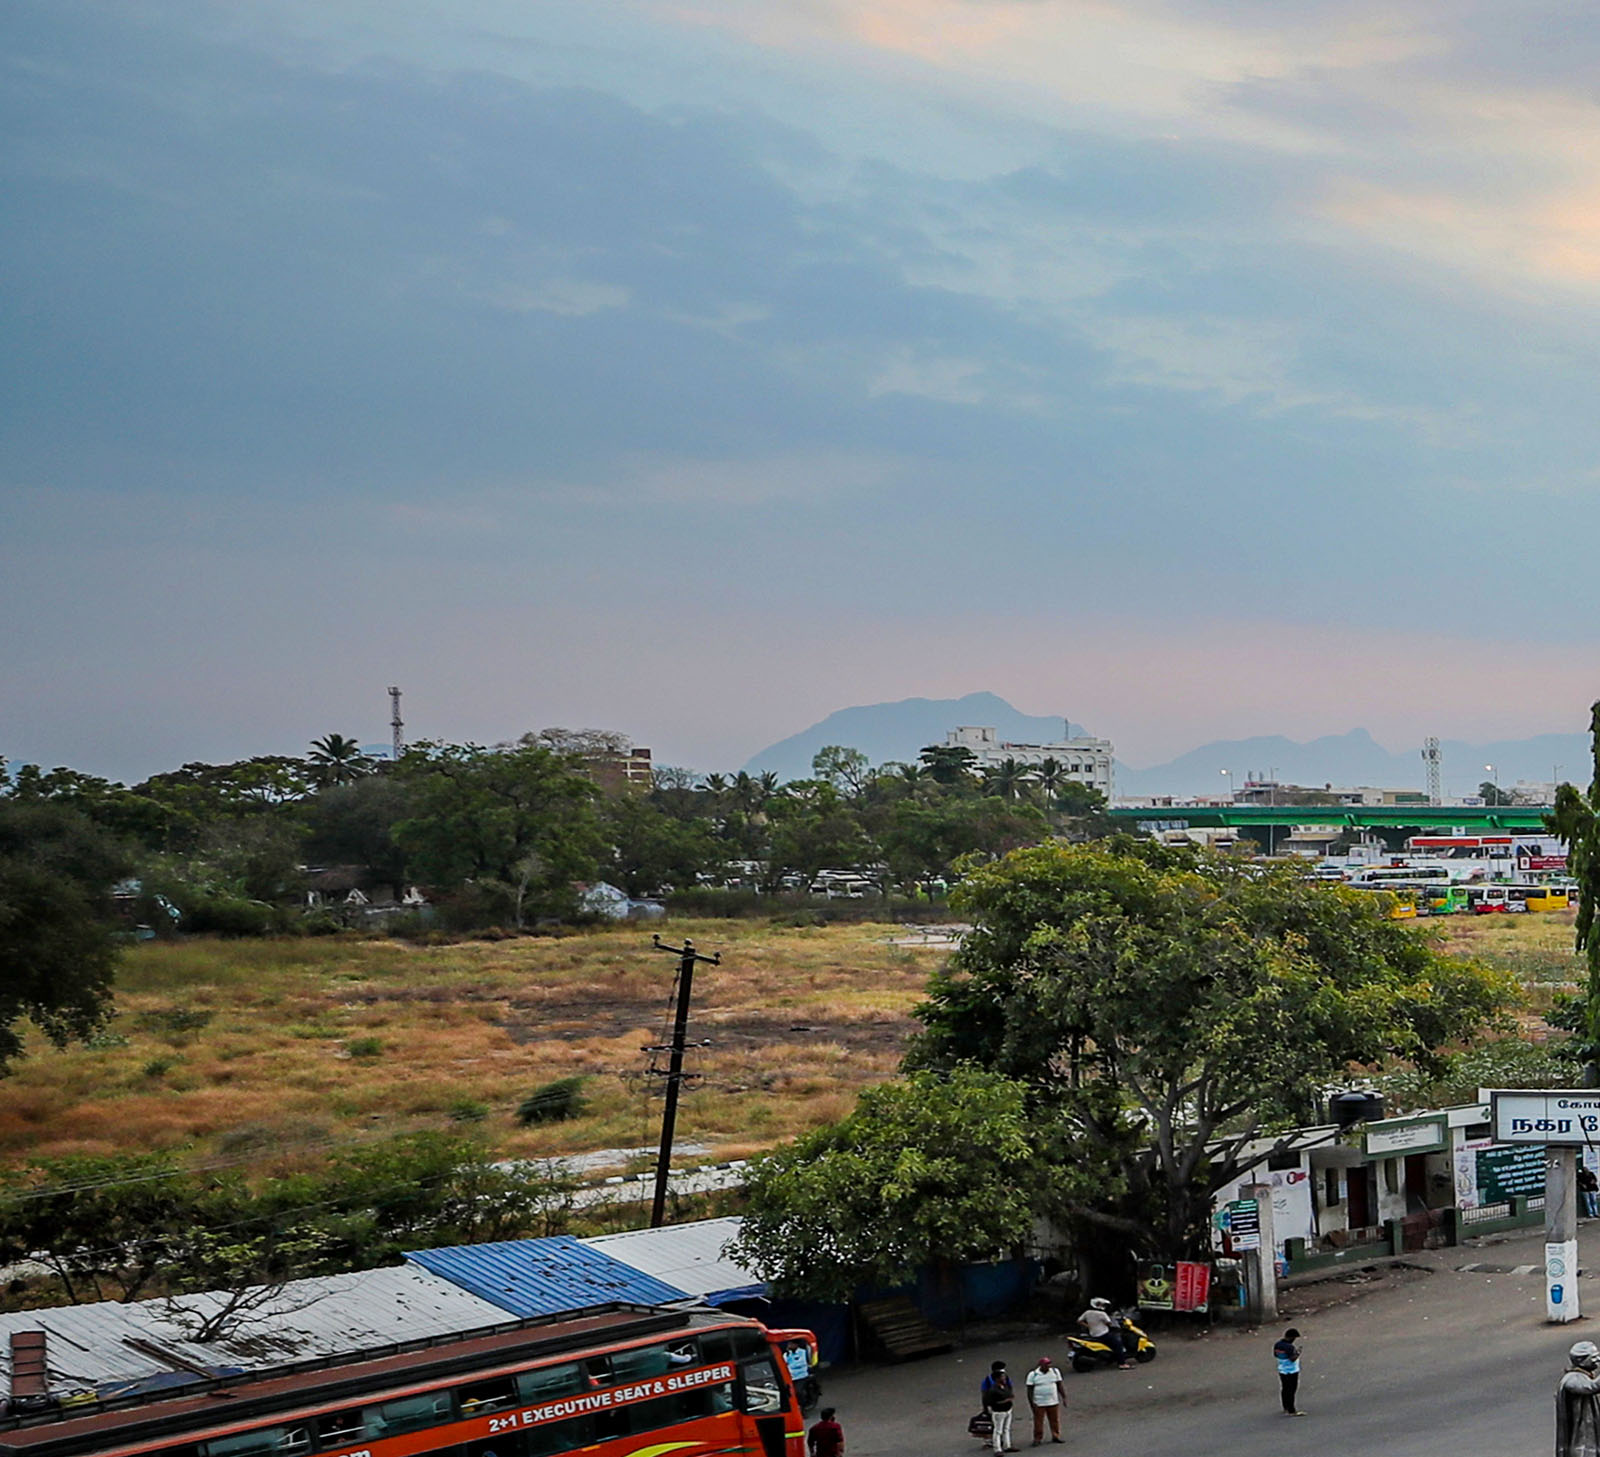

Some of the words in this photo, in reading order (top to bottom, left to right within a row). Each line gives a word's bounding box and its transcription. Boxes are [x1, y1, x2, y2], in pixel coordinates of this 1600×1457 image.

[1511, 1115, 1573, 1134] நகர
[489, 1415, 517, 1433] 2+1
[522, 1393, 611, 1425] EXECUTIVE
[614, 1385, 652, 1404] SEAT
[653, 1382, 665, 1393] &
[667, 1365, 731, 1391] SLEEPER
